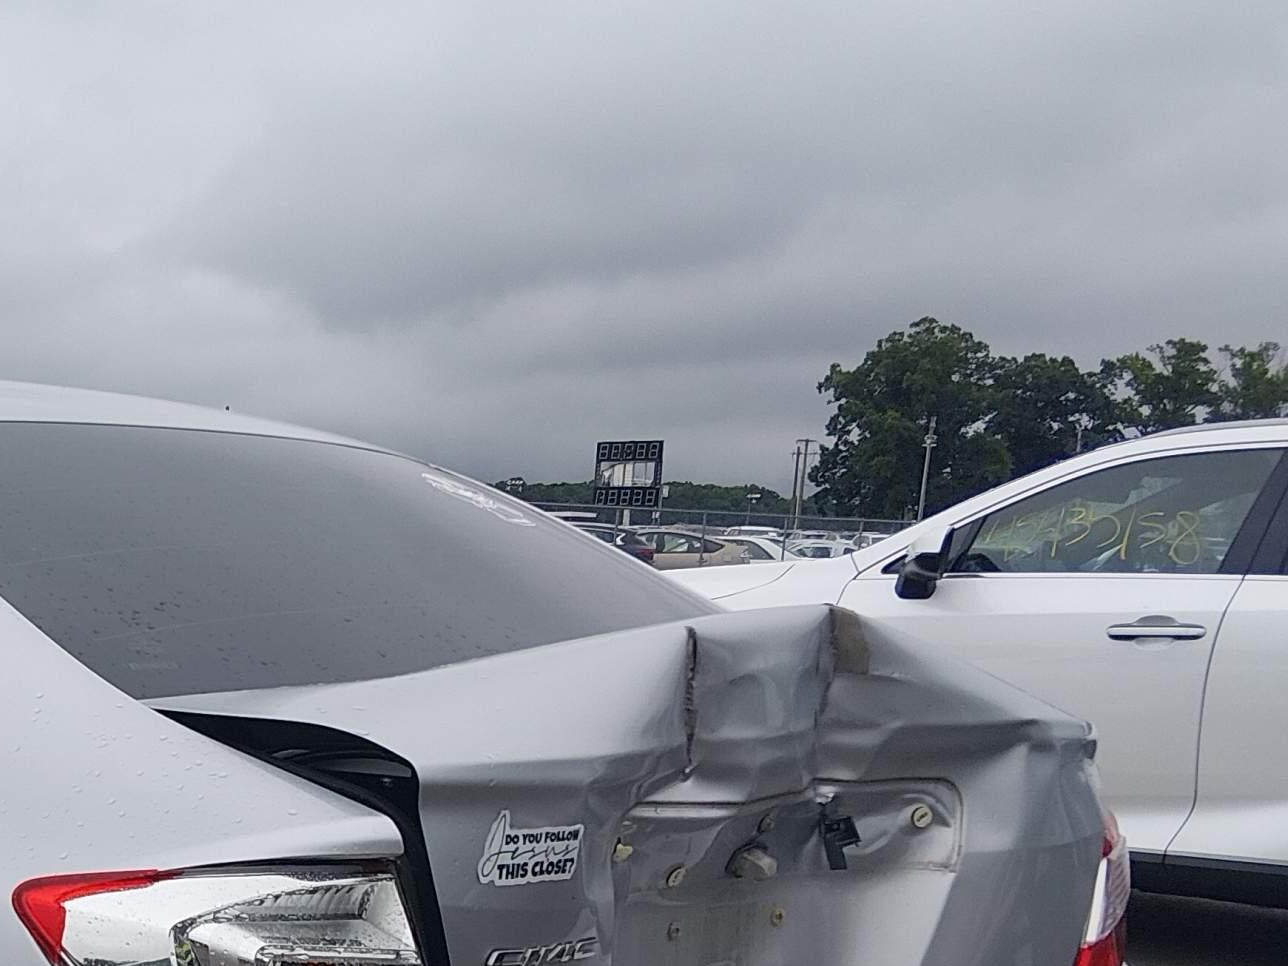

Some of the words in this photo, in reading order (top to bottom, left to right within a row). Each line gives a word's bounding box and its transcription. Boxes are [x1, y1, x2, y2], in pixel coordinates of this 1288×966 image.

[505, 834, 520, 845] DO
[522, 832, 542, 845] YOU
[544, 830, 579, 843] FOLLOW
[497, 862, 529, 880] THIS
[532, 857, 574, 877] CLOSE?
